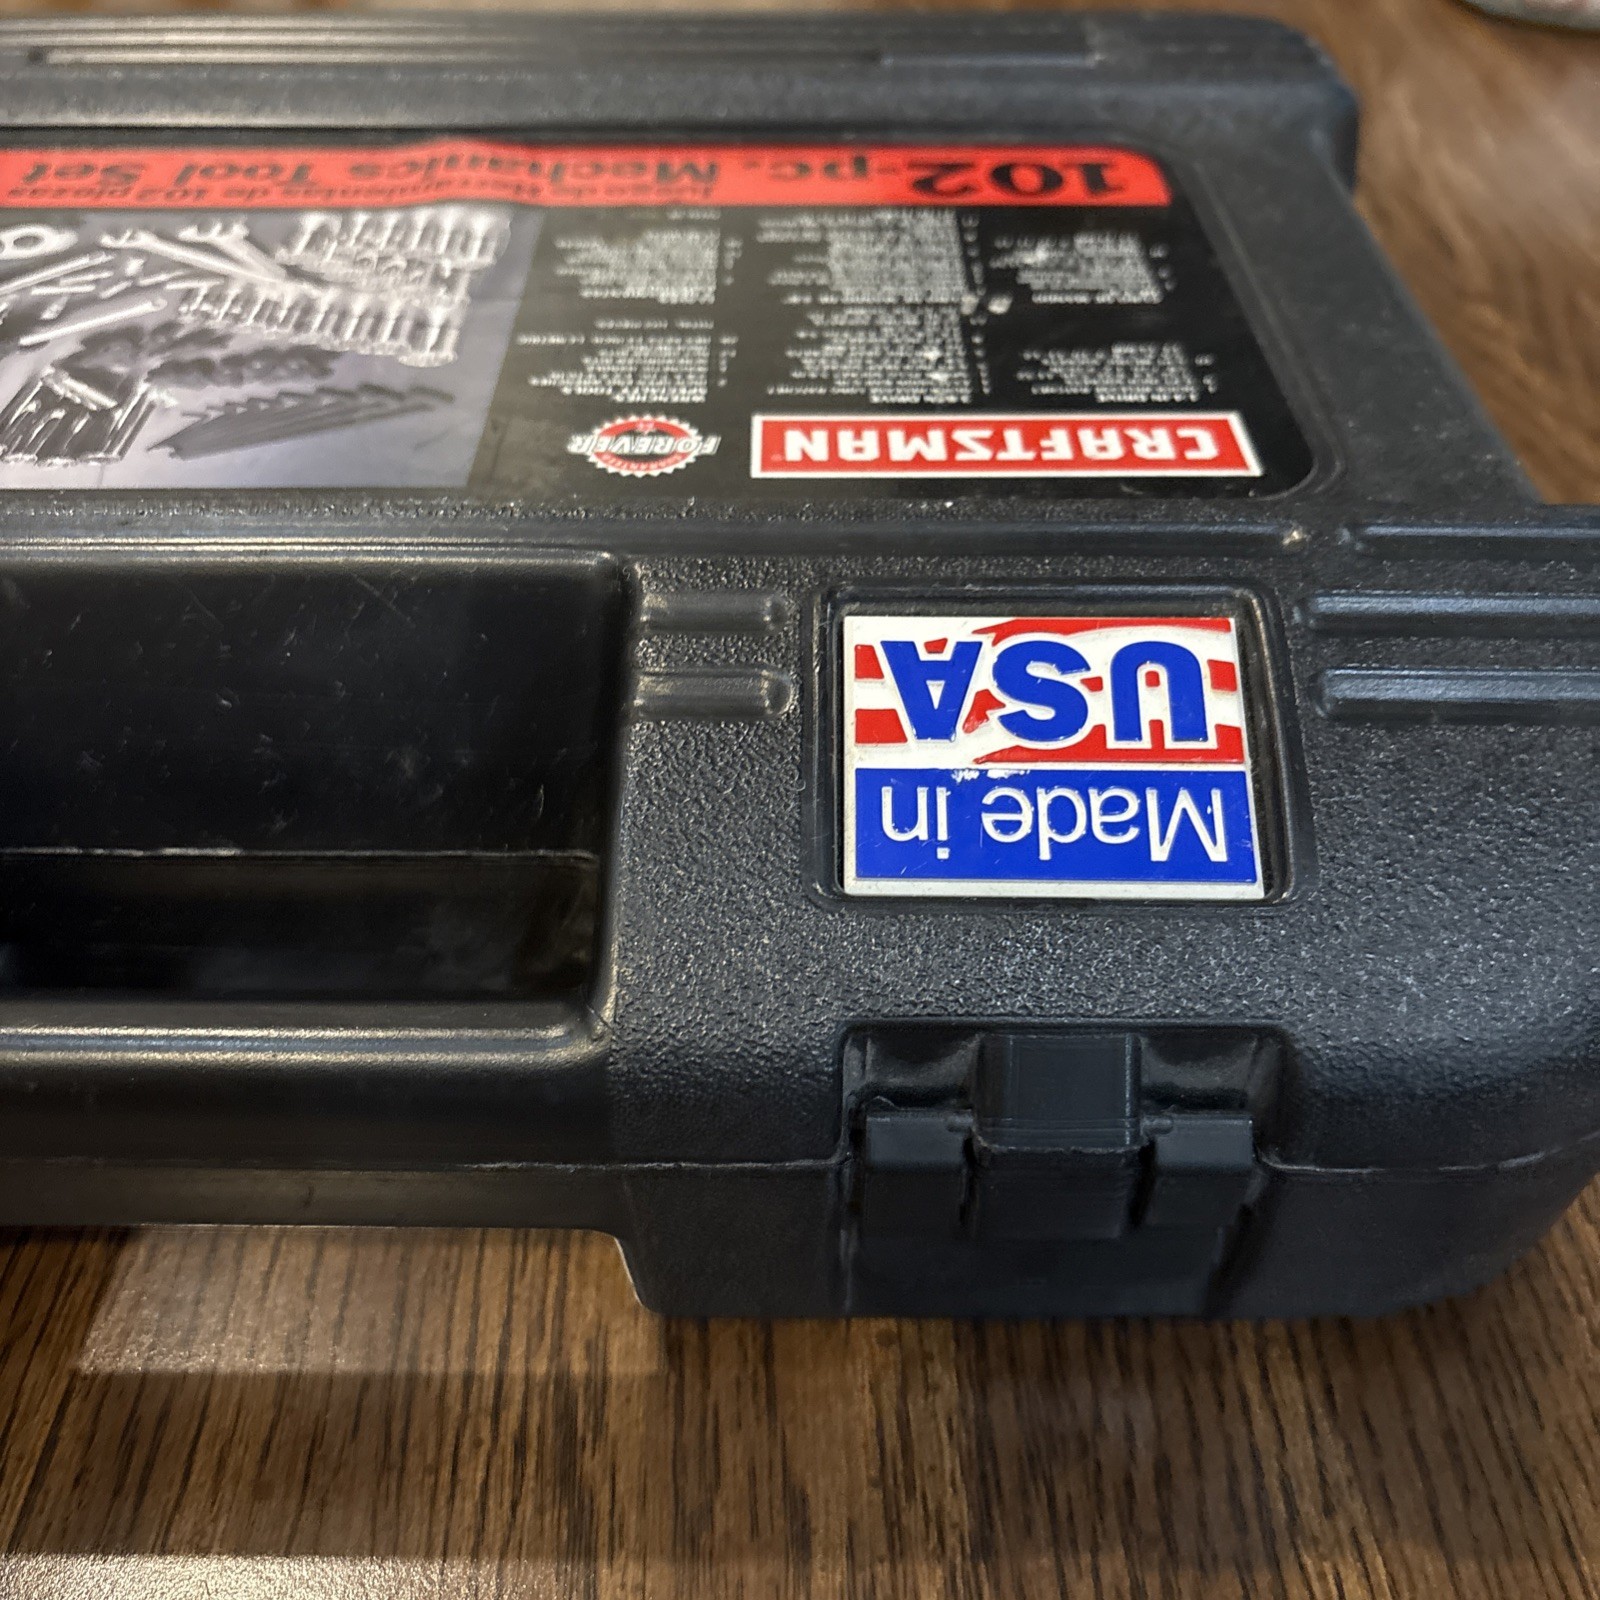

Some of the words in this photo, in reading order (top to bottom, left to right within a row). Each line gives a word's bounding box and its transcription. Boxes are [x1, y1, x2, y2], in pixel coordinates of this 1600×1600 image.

[22, 162, 145, 190] Set
[173, 163, 317, 189] Tool
[566, 434, 721, 455] FOREVER
[782, 428, 1219, 462] CRAFTSMAN
[880, 639, 1210, 745] USA
[880, 785, 951, 860] in
[980, 785, 1229, 863] Made
